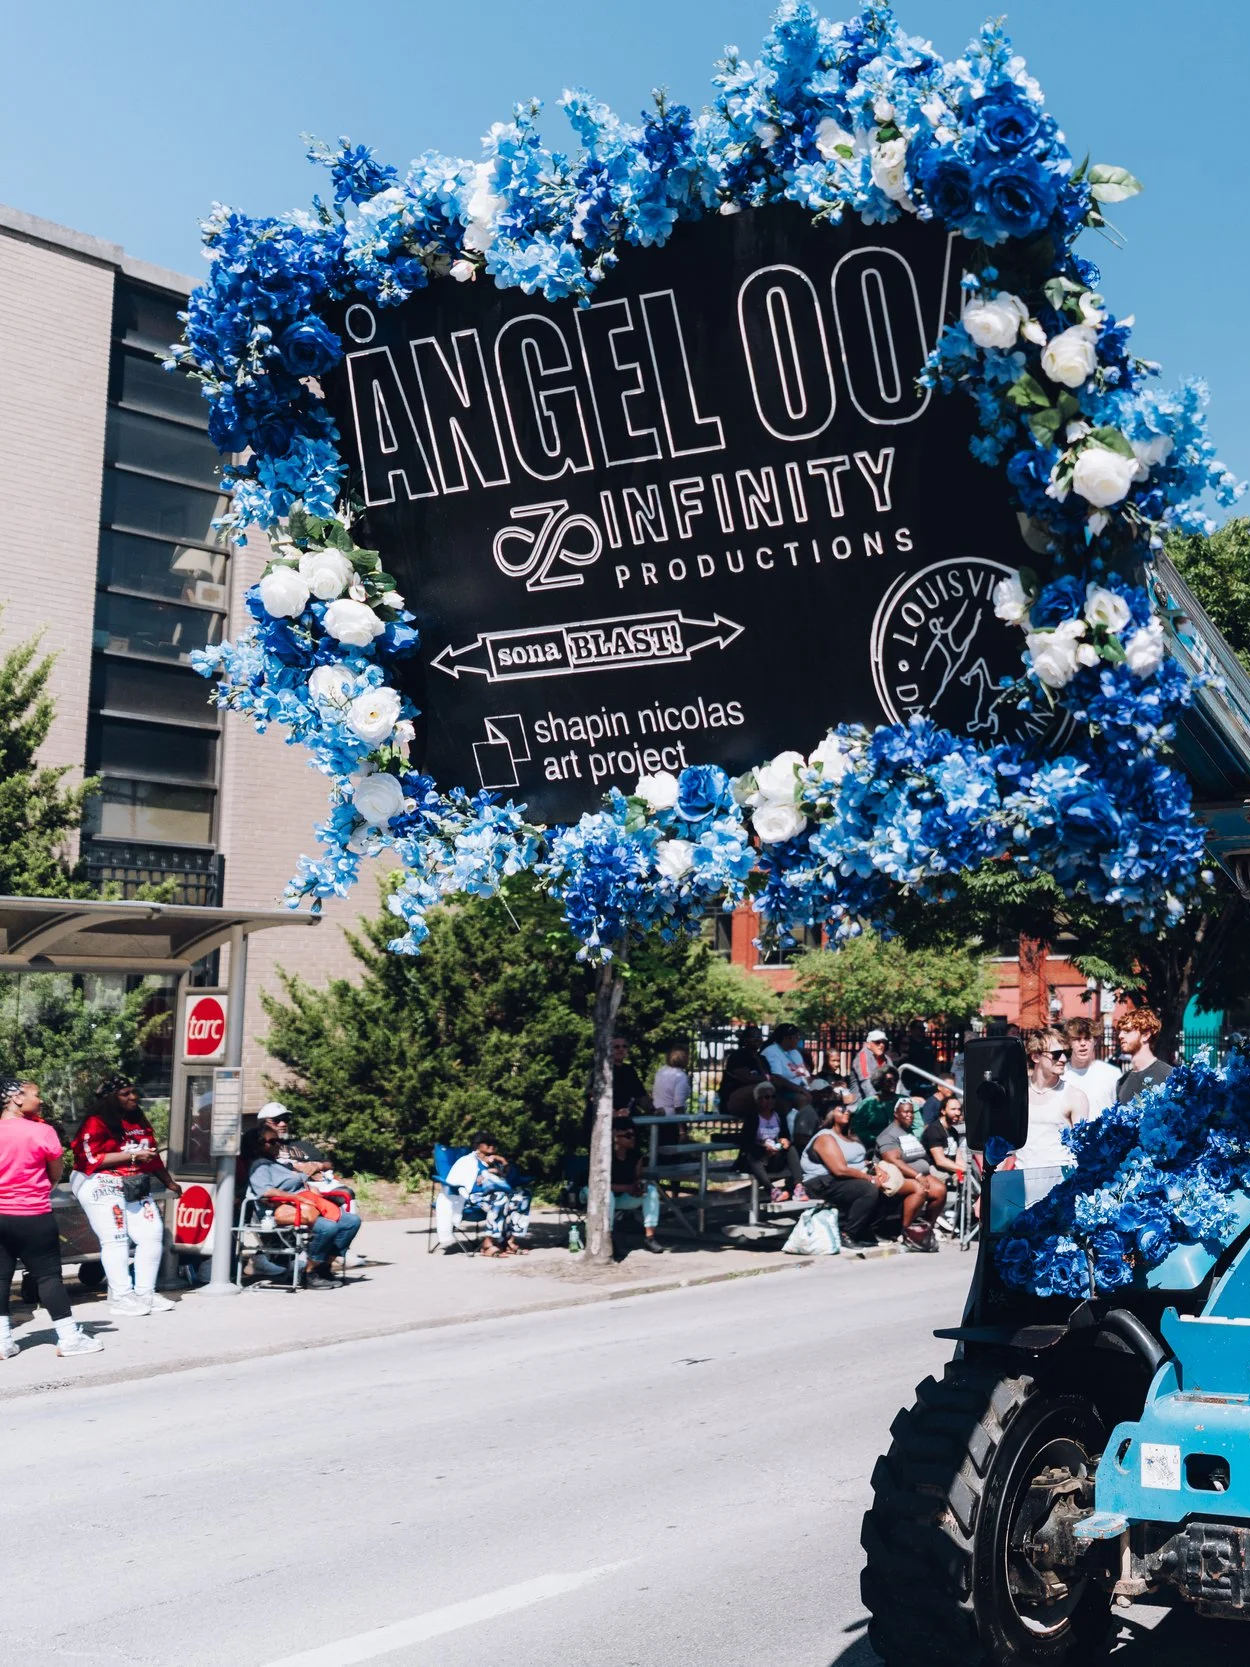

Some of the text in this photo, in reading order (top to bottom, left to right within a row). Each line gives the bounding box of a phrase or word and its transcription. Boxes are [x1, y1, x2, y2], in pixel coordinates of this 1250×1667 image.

[600, 447, 896, 549] INFINITY
[614, 527, 914, 589] PRODUCTIONS
[893, 568, 996, 647] LOUISVI
[498, 621, 684, 667] sona BLAST!
[535, 697, 745, 748] shapin nicolas
[543, 740, 690, 785] art project
[188, 1015, 224, 1040] tarc
[177, 1205, 212, 1230] tarc
